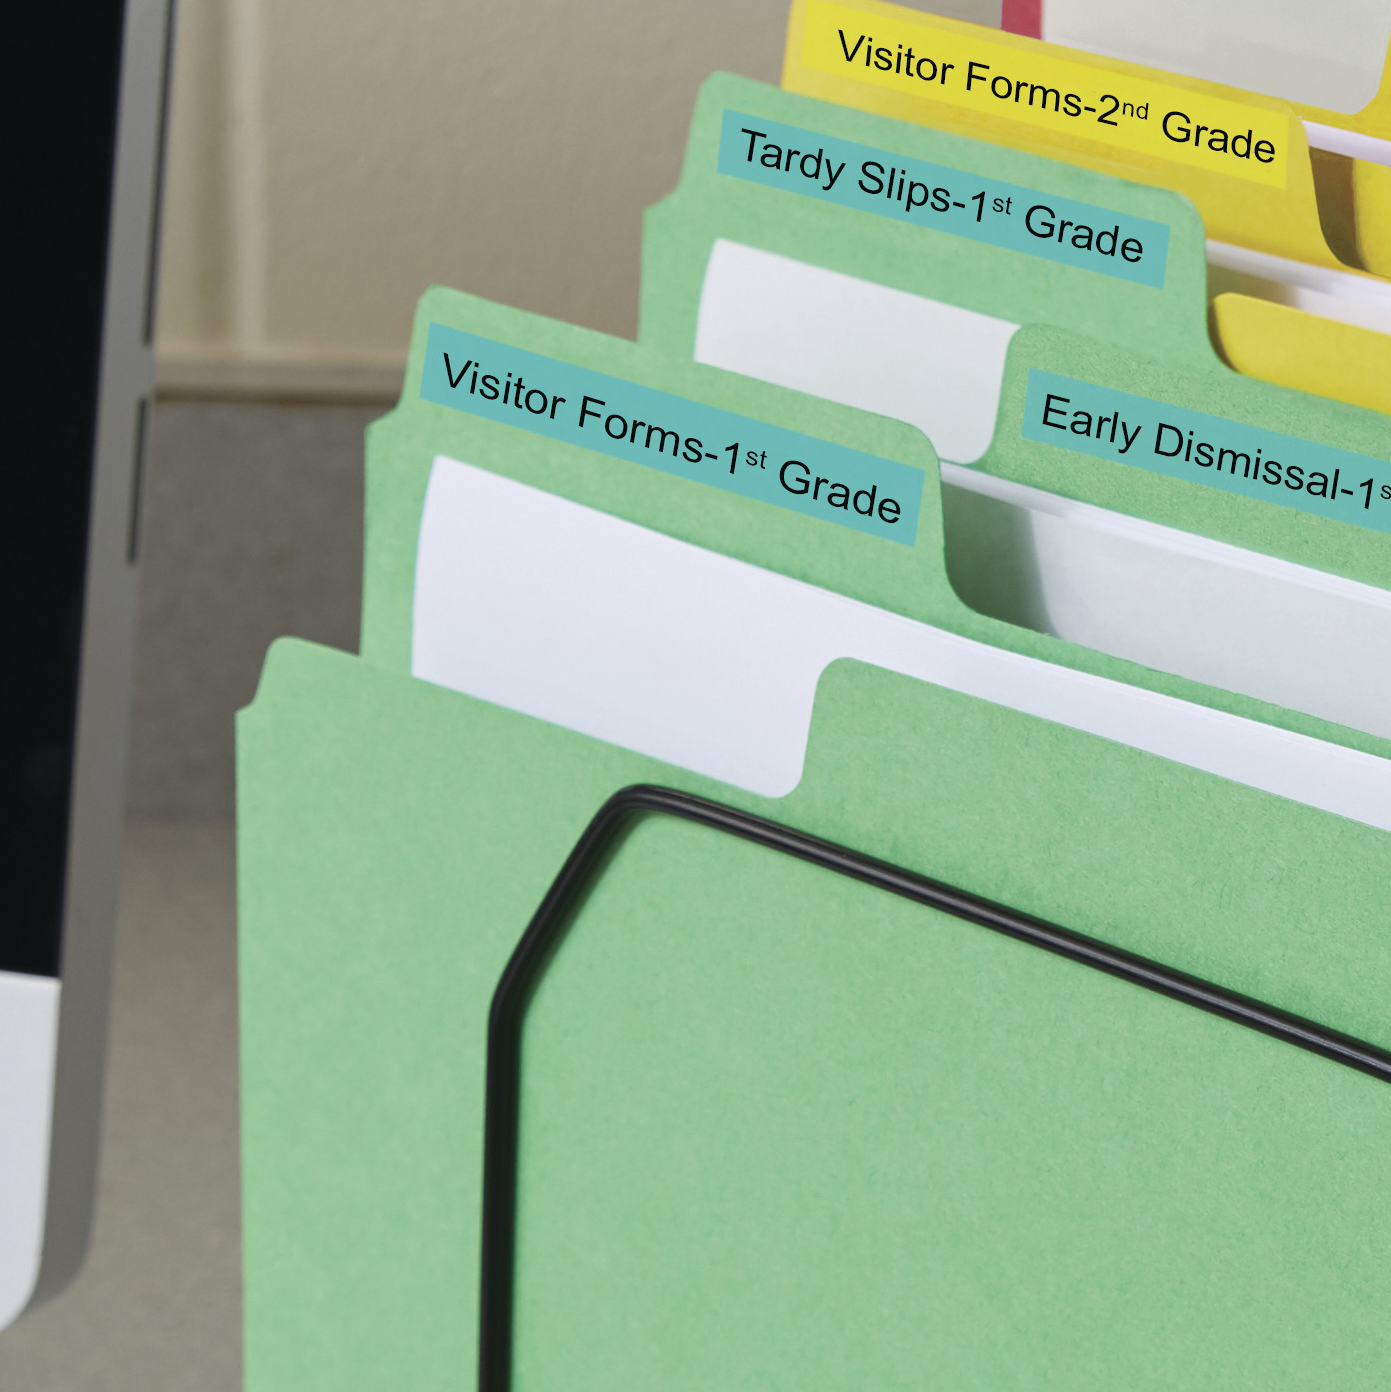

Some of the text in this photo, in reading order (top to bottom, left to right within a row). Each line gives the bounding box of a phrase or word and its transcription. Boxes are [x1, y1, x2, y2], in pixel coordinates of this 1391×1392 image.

[837, 28, 1277, 165] Visitor Forms-2nd Grade
[740, 126, 1144, 264] Tardy Slips-1st Grade
[442, 351, 902, 525] Visitor Forms-1st Grade
[1041, 392, 1143, 455] Early
